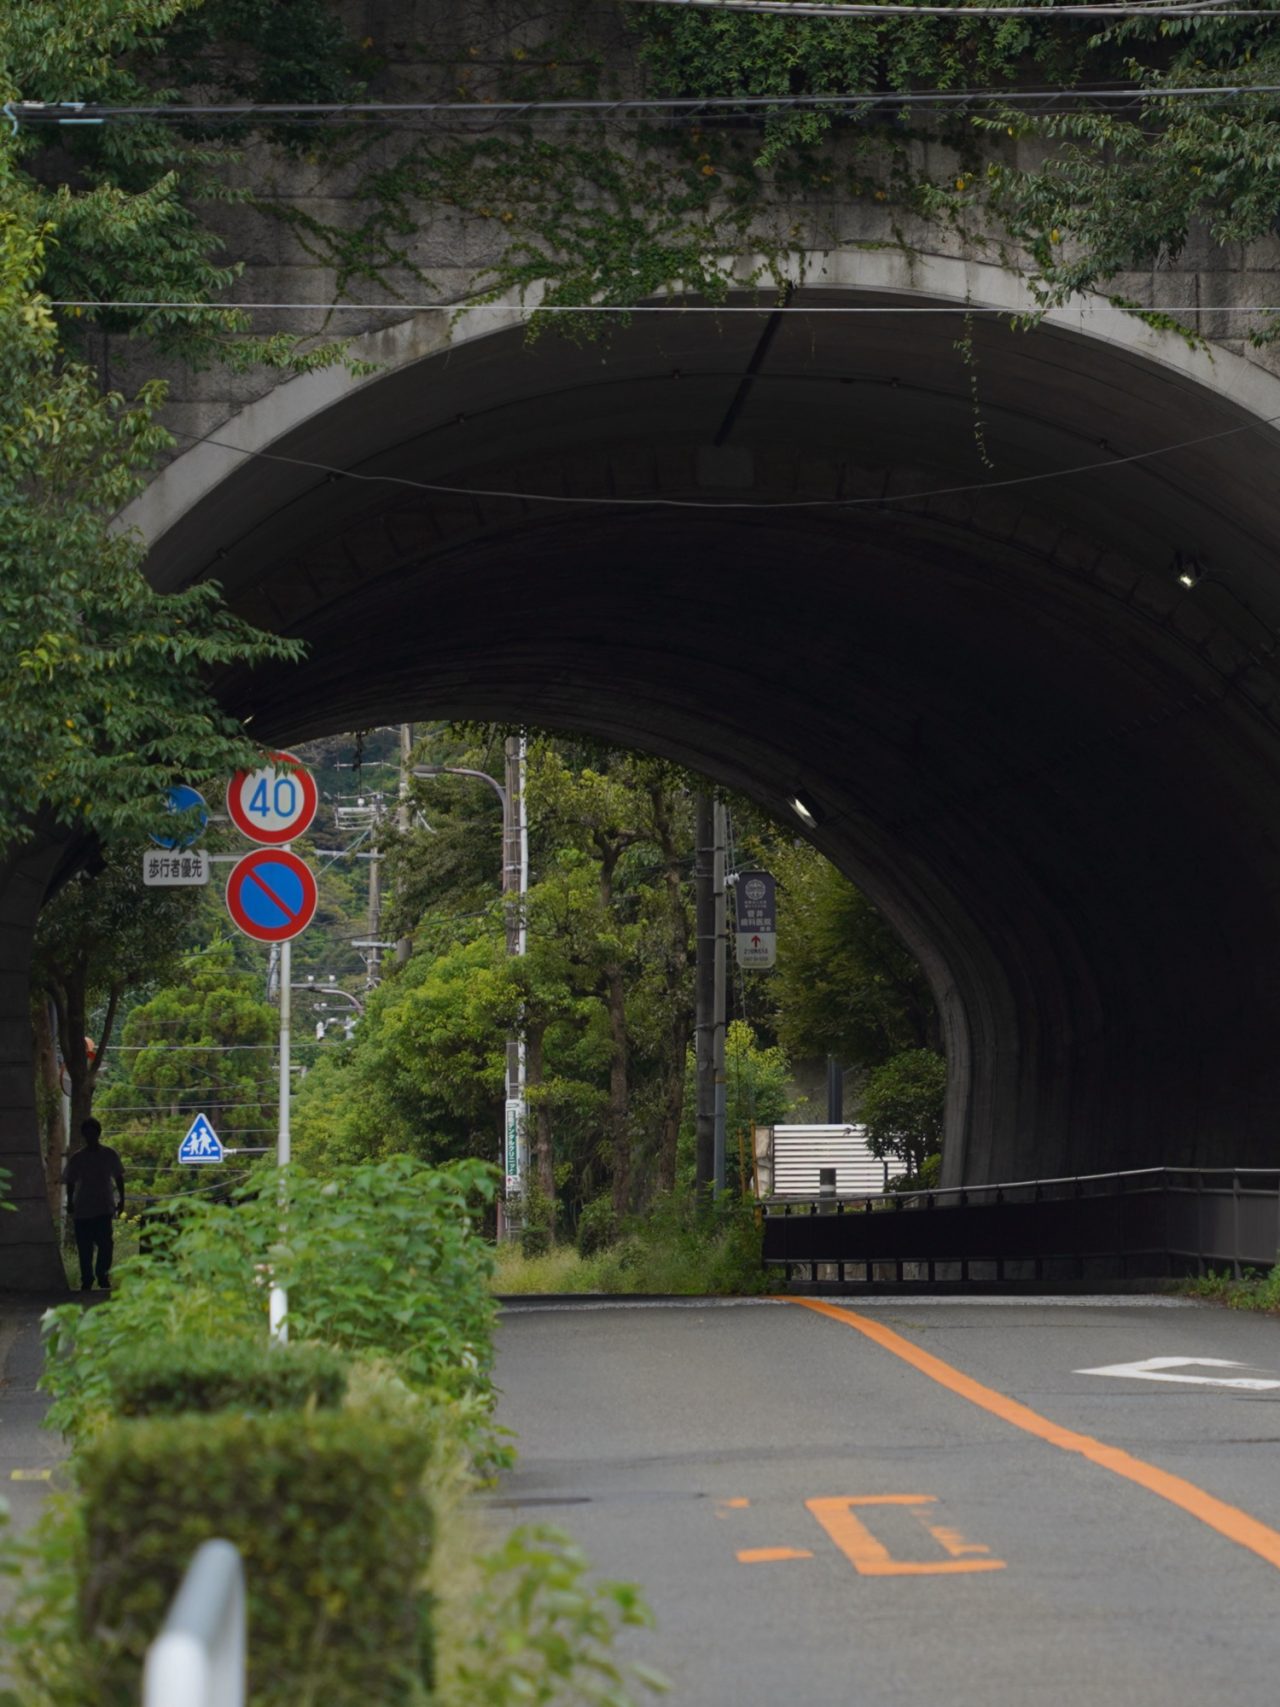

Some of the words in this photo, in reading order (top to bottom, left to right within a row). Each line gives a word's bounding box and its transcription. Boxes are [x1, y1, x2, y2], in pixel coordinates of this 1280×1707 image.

[249, 778, 296, 818] 40
[148, 857, 203, 879] 歩行者優先
